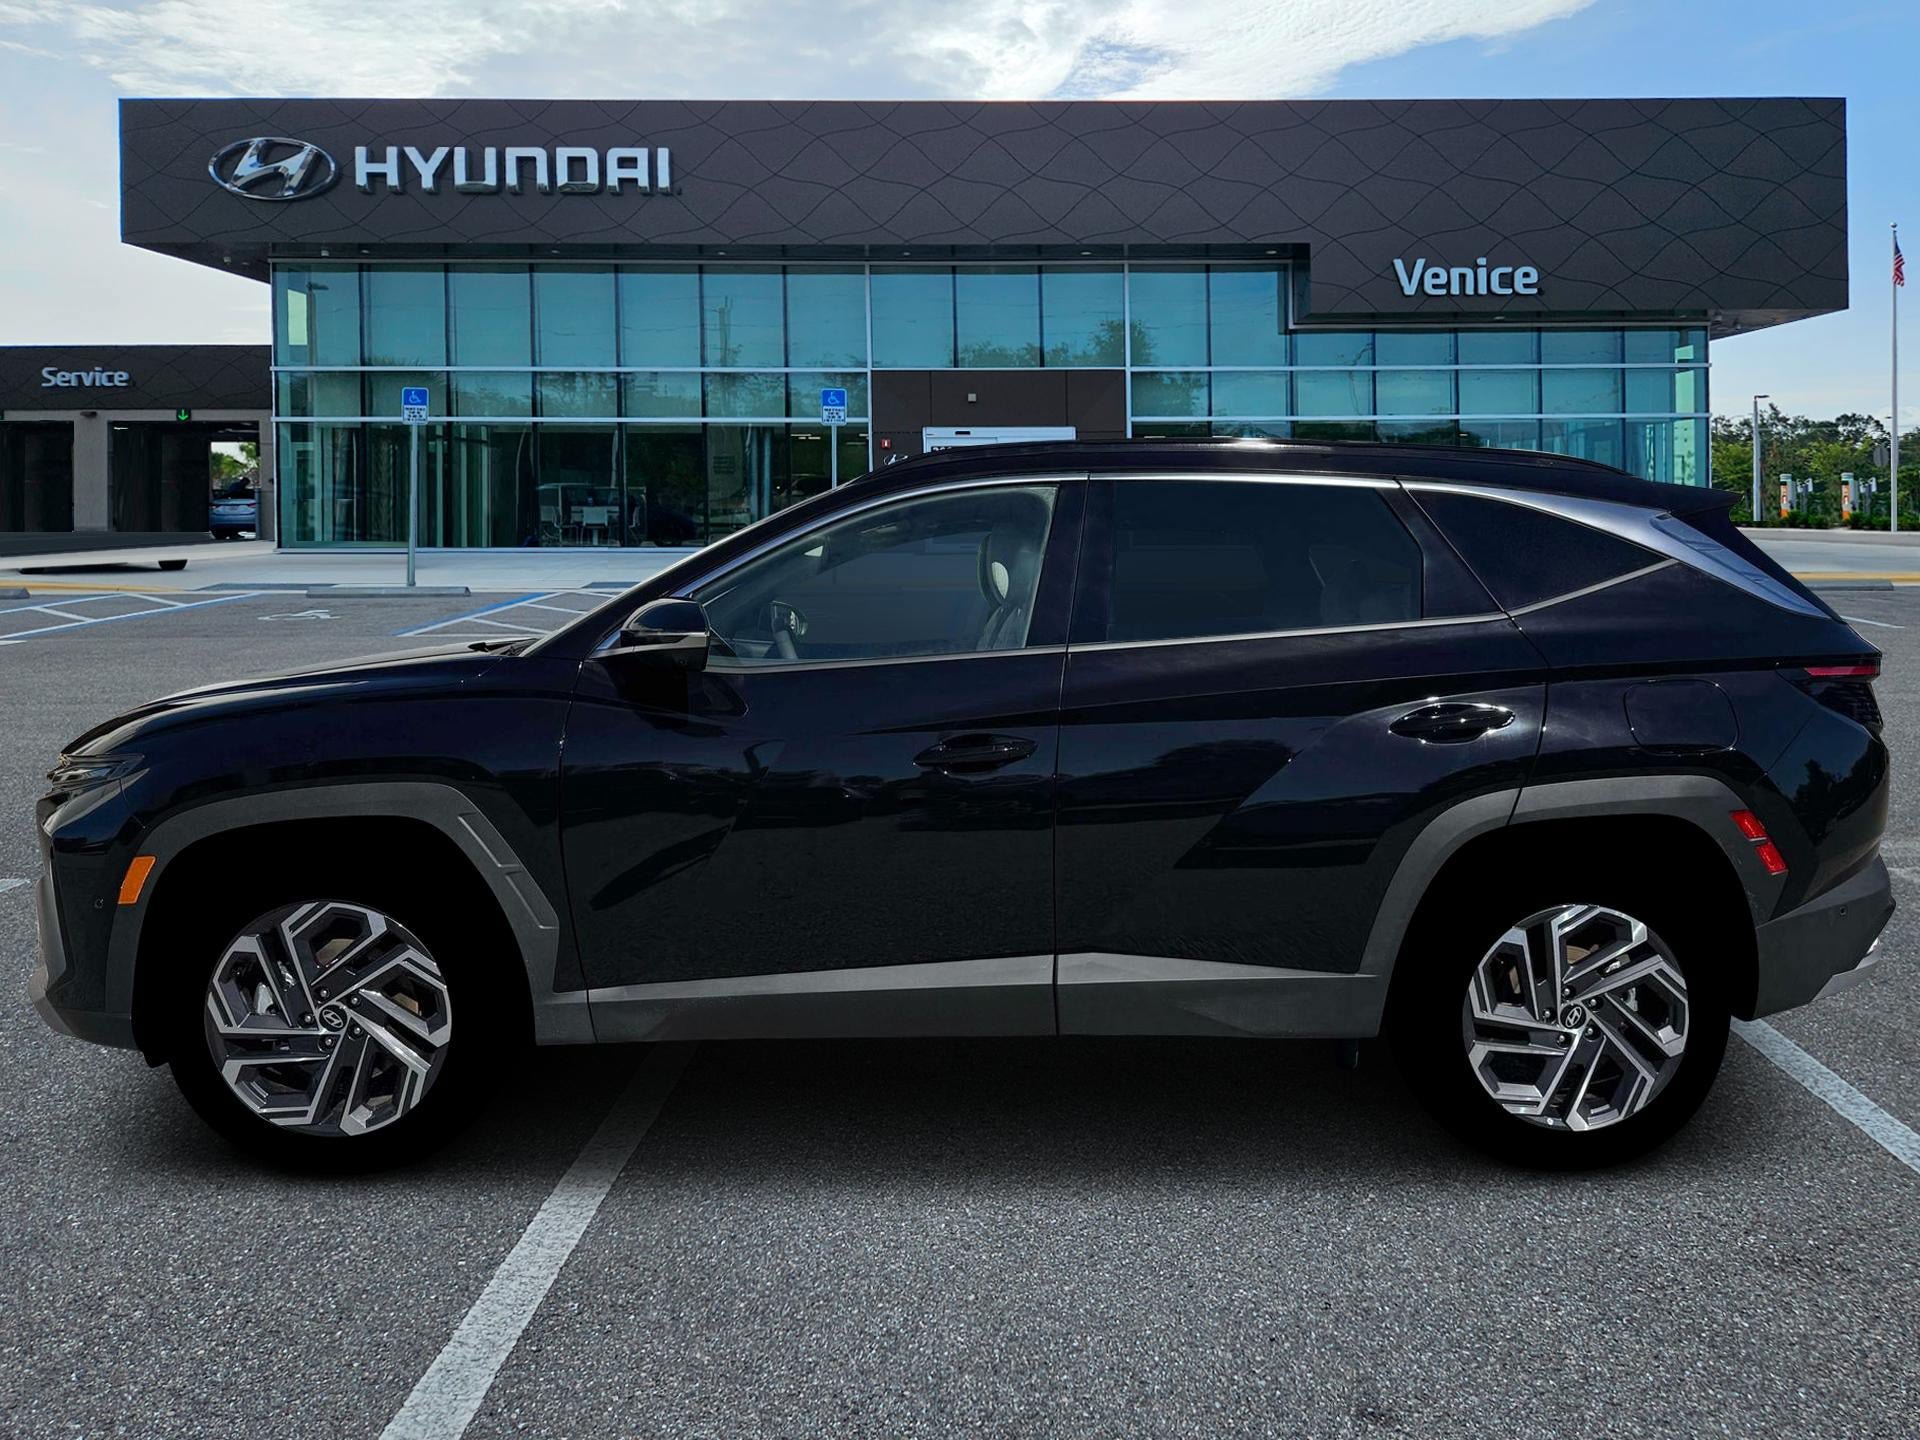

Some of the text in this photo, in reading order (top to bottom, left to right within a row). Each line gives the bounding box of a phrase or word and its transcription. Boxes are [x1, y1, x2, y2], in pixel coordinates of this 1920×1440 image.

[354, 145, 674, 195] HYUNDAI
[1392, 256, 1539, 296] Venice
[41, 366, 130, 387] Service
